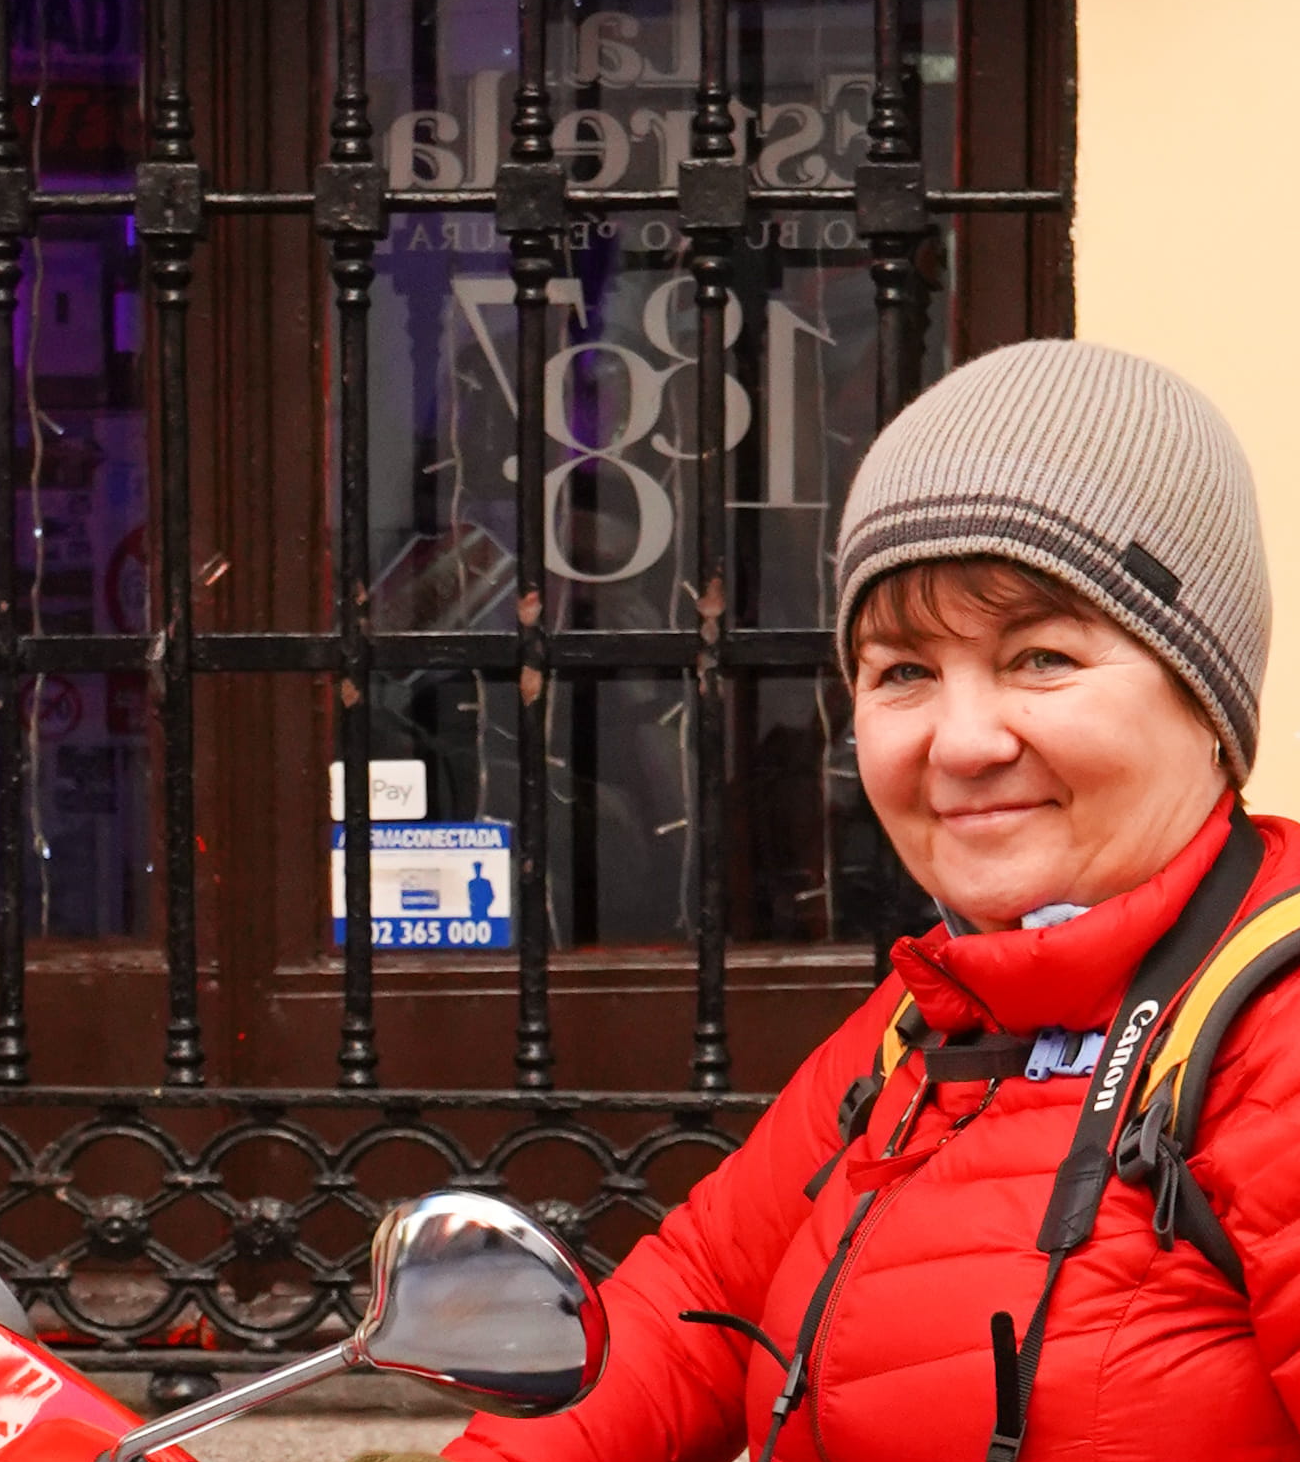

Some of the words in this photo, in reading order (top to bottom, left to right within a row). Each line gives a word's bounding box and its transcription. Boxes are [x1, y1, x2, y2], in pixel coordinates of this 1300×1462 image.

[372, 778, 414, 806] Pay
[400, 920, 442, 945] 365
[448, 920, 492, 945] 000
[1093, 999, 1160, 1112] Canon
